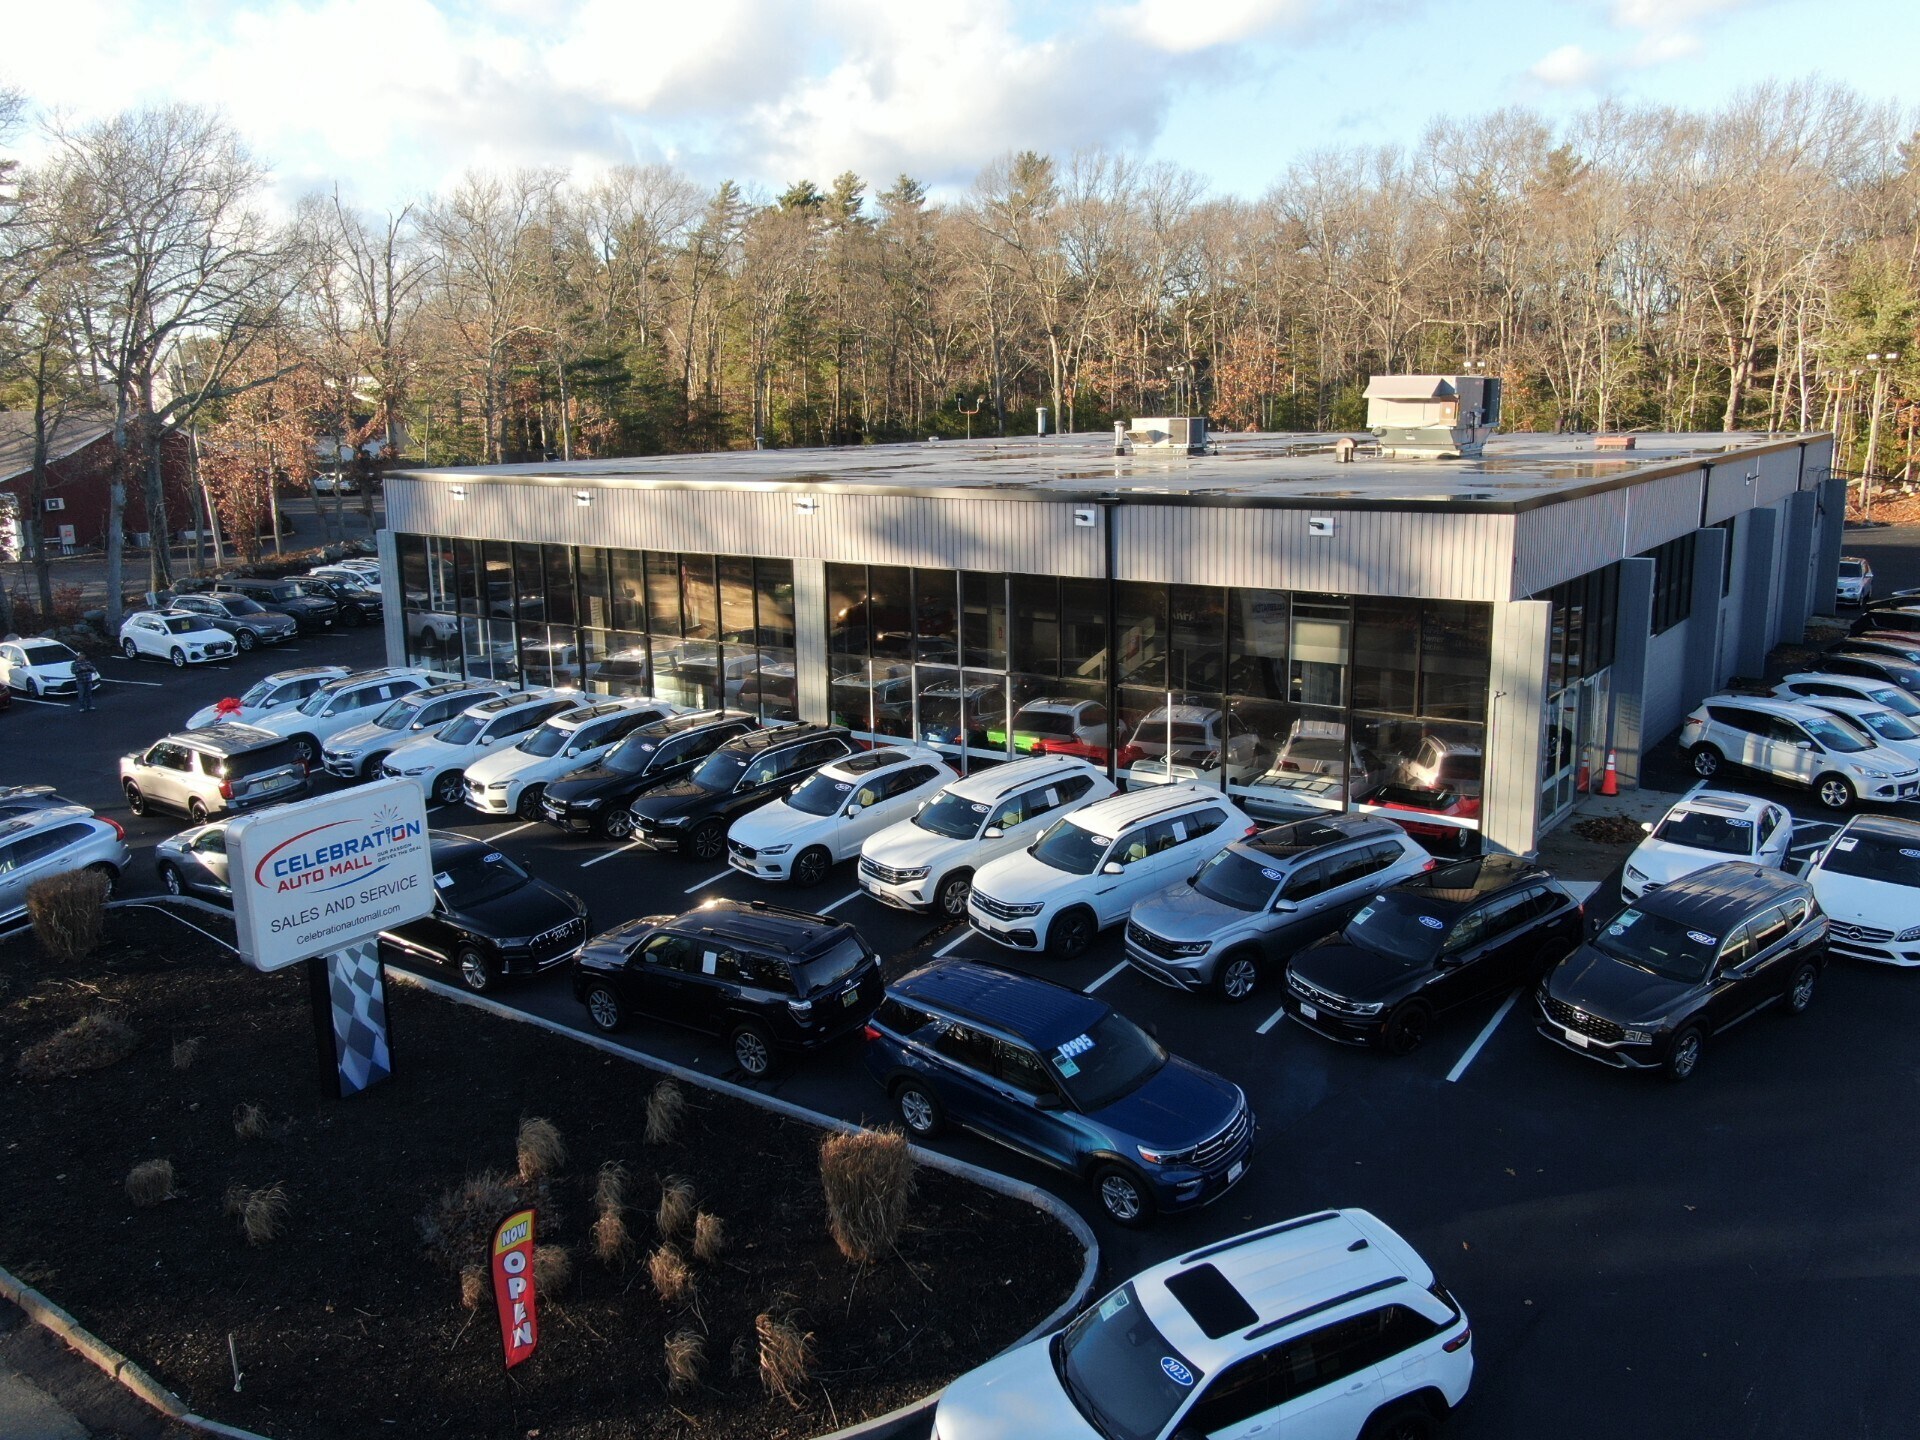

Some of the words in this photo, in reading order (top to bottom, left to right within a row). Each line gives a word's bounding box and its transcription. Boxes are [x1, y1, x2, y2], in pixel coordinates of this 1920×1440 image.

[274, 820, 421, 877] CELEBRATION
[277, 868, 325, 893] AUTO
[329, 855, 373, 877] MALL
[271, 907, 320, 933] SALES
[324, 895, 355, 916] AND
[360, 874, 418, 904] SERVICE
[296, 904, 401, 945] Celebrationautomall.com
[1057, 1033, 1095, 1059] 19995
[501, 1220, 528, 1247] NOW
[503, 1251, 533, 1349] OPEN
[1163, 1360, 1190, 1380] 2023
